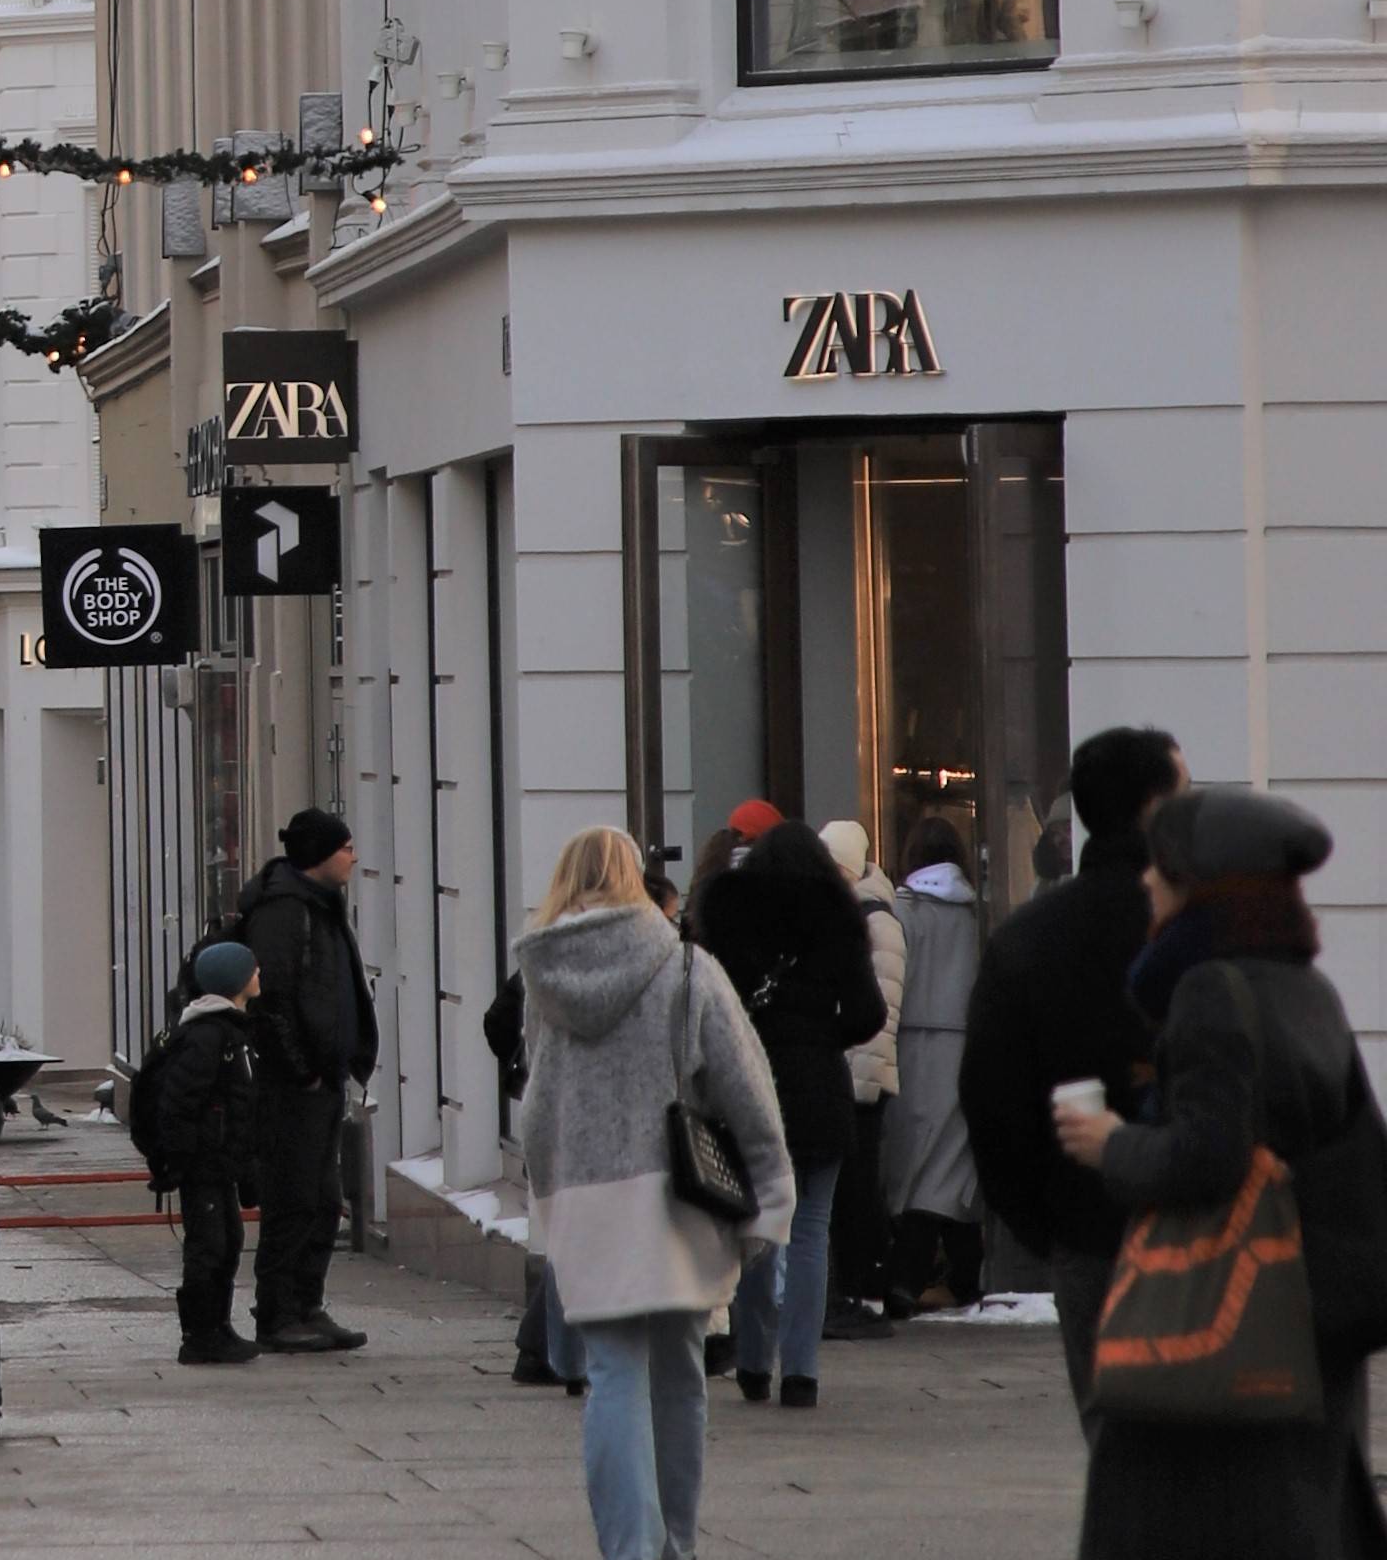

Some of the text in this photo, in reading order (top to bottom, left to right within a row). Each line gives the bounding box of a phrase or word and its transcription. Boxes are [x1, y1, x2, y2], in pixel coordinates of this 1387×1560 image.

[783, 289, 947, 379] ZARA
[226, 381, 349, 439] ZARA
[94, 577, 129, 591] THE
[83, 592, 143, 610] BODY
[87, 610, 141, 627] SHOP
